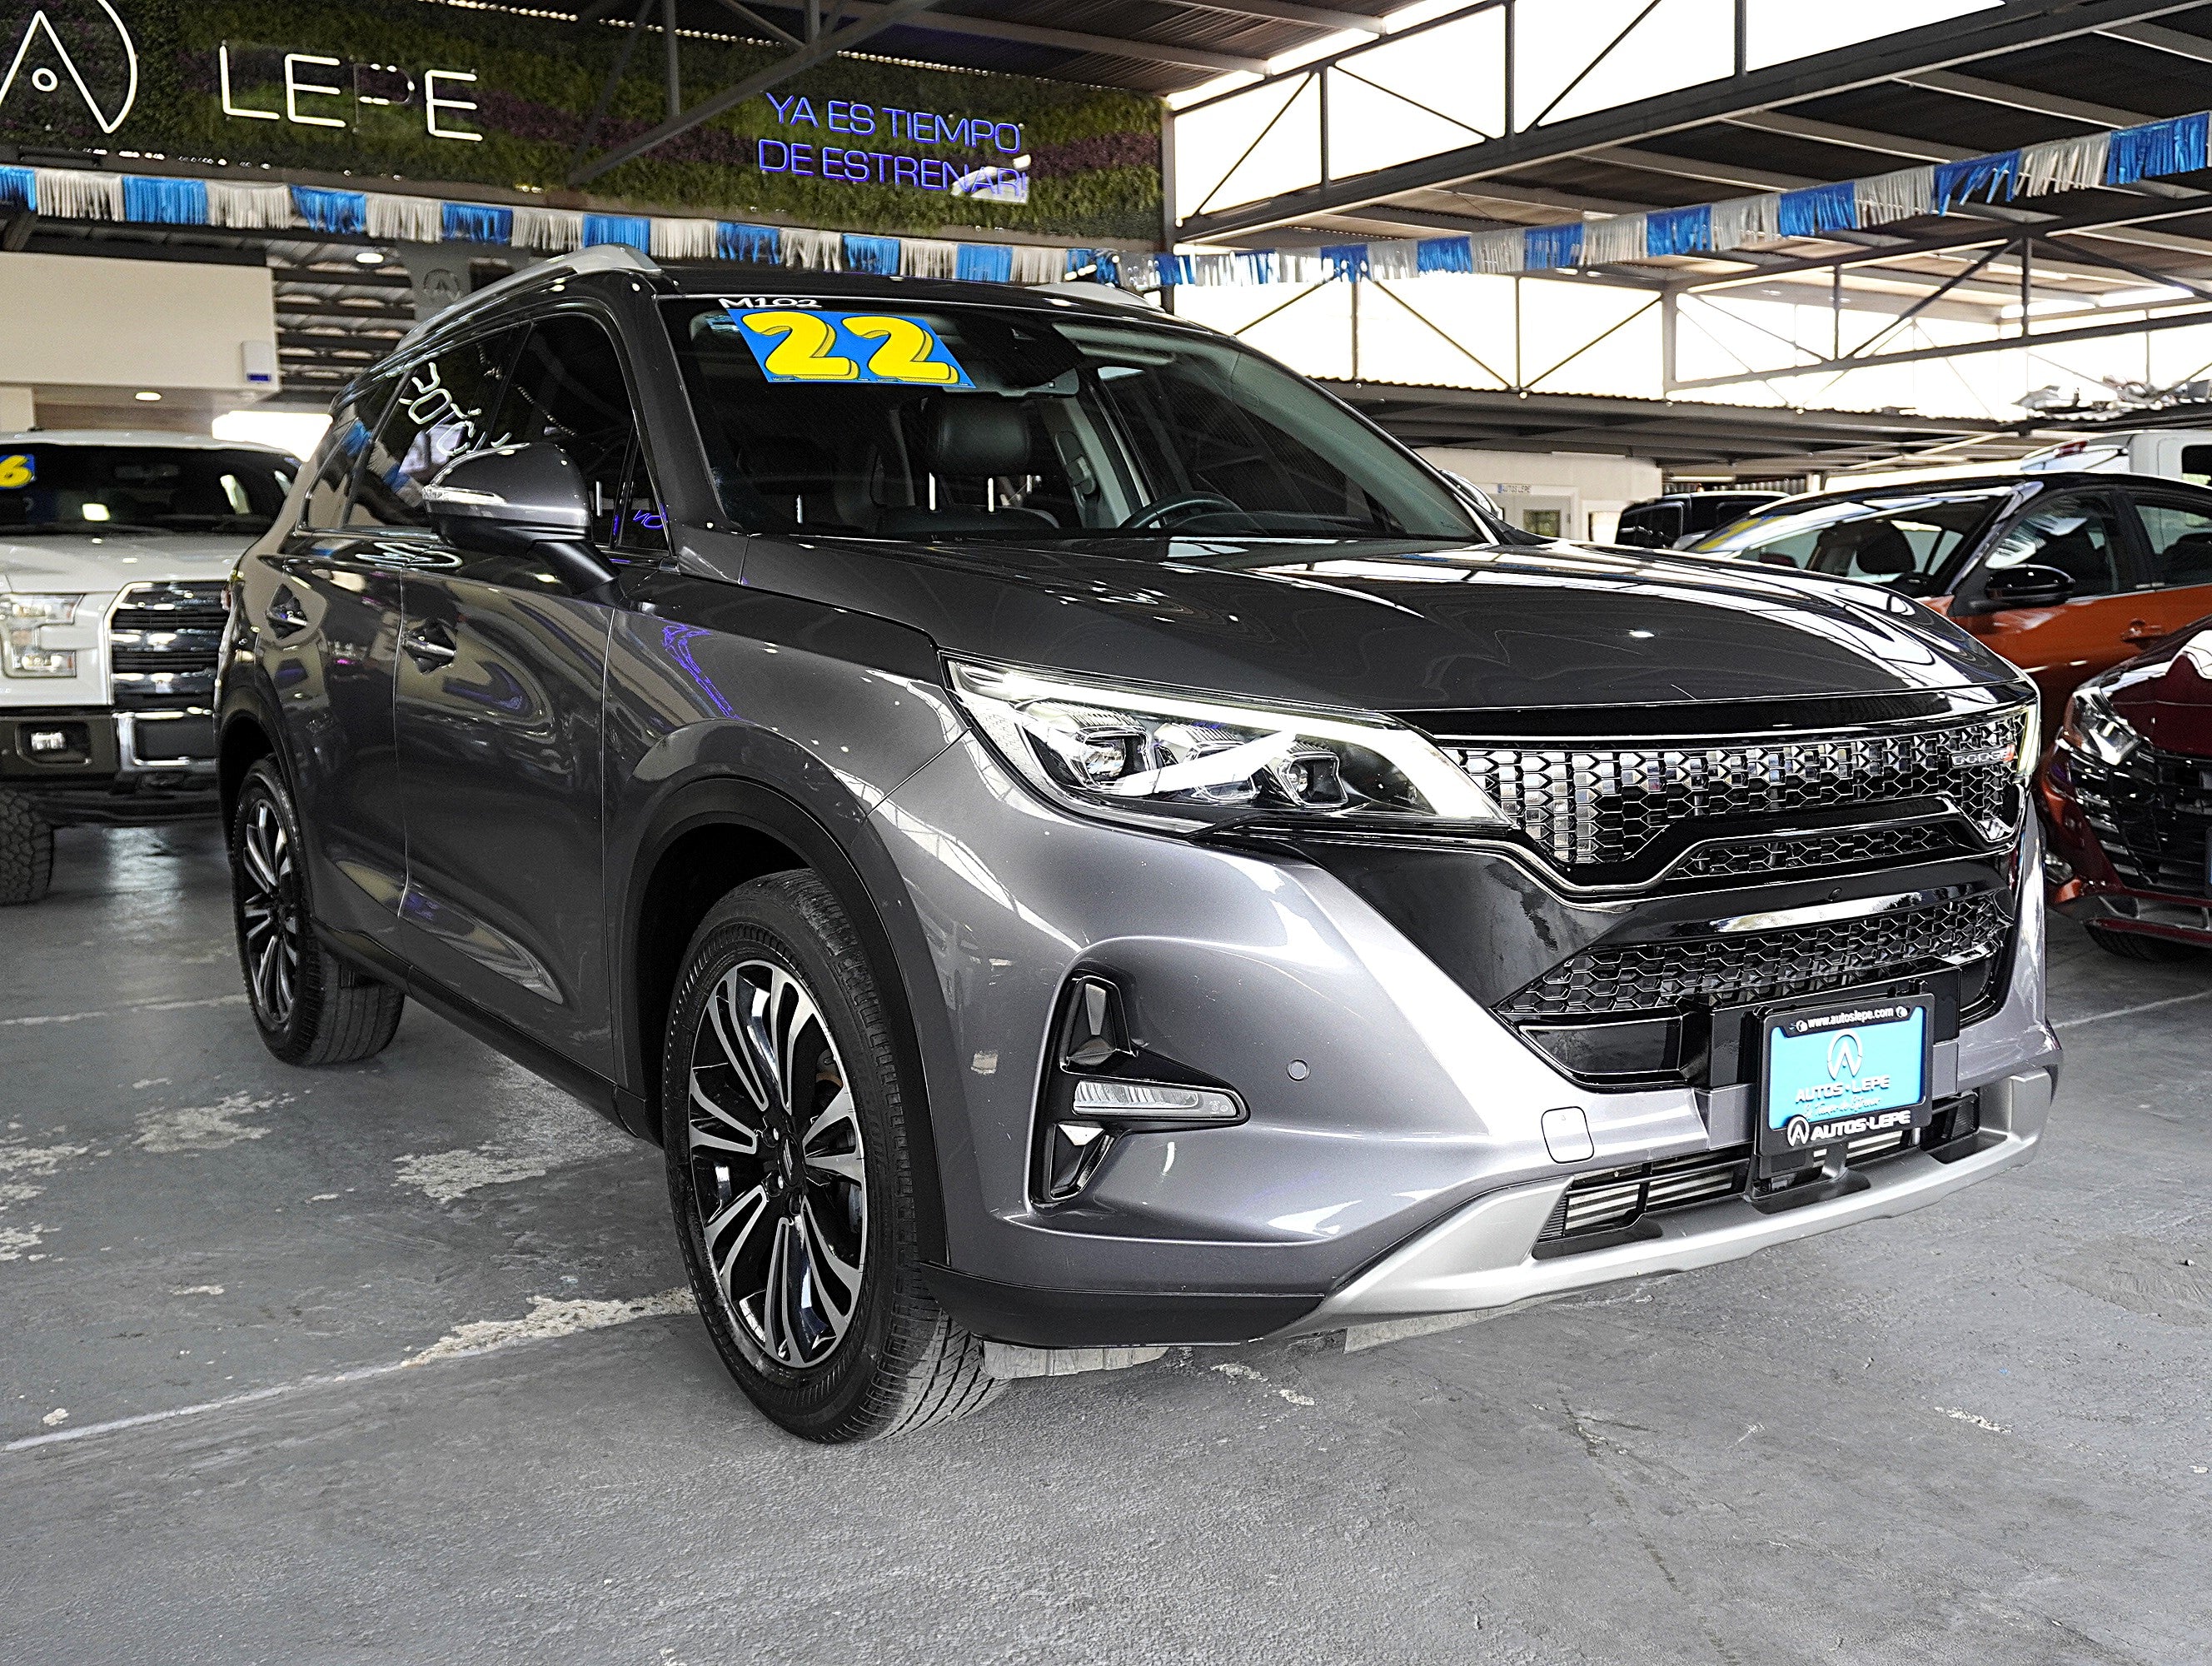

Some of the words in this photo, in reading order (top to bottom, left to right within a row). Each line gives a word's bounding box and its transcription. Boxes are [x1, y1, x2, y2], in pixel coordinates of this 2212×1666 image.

[220, 43, 482, 140] LEPE
[765, 92, 819, 127] YA
[828, 100, 876, 136] ES
[882, 107, 1021, 153] TIEMPO
[758, 139, 814, 176] DE
[718, 297, 822, 308] M102
[741, 311, 959, 384] 22
[1951, 750, 2008, 766] DODGE
[1807, 1007, 1894, 1028] www.autoslepe.com
